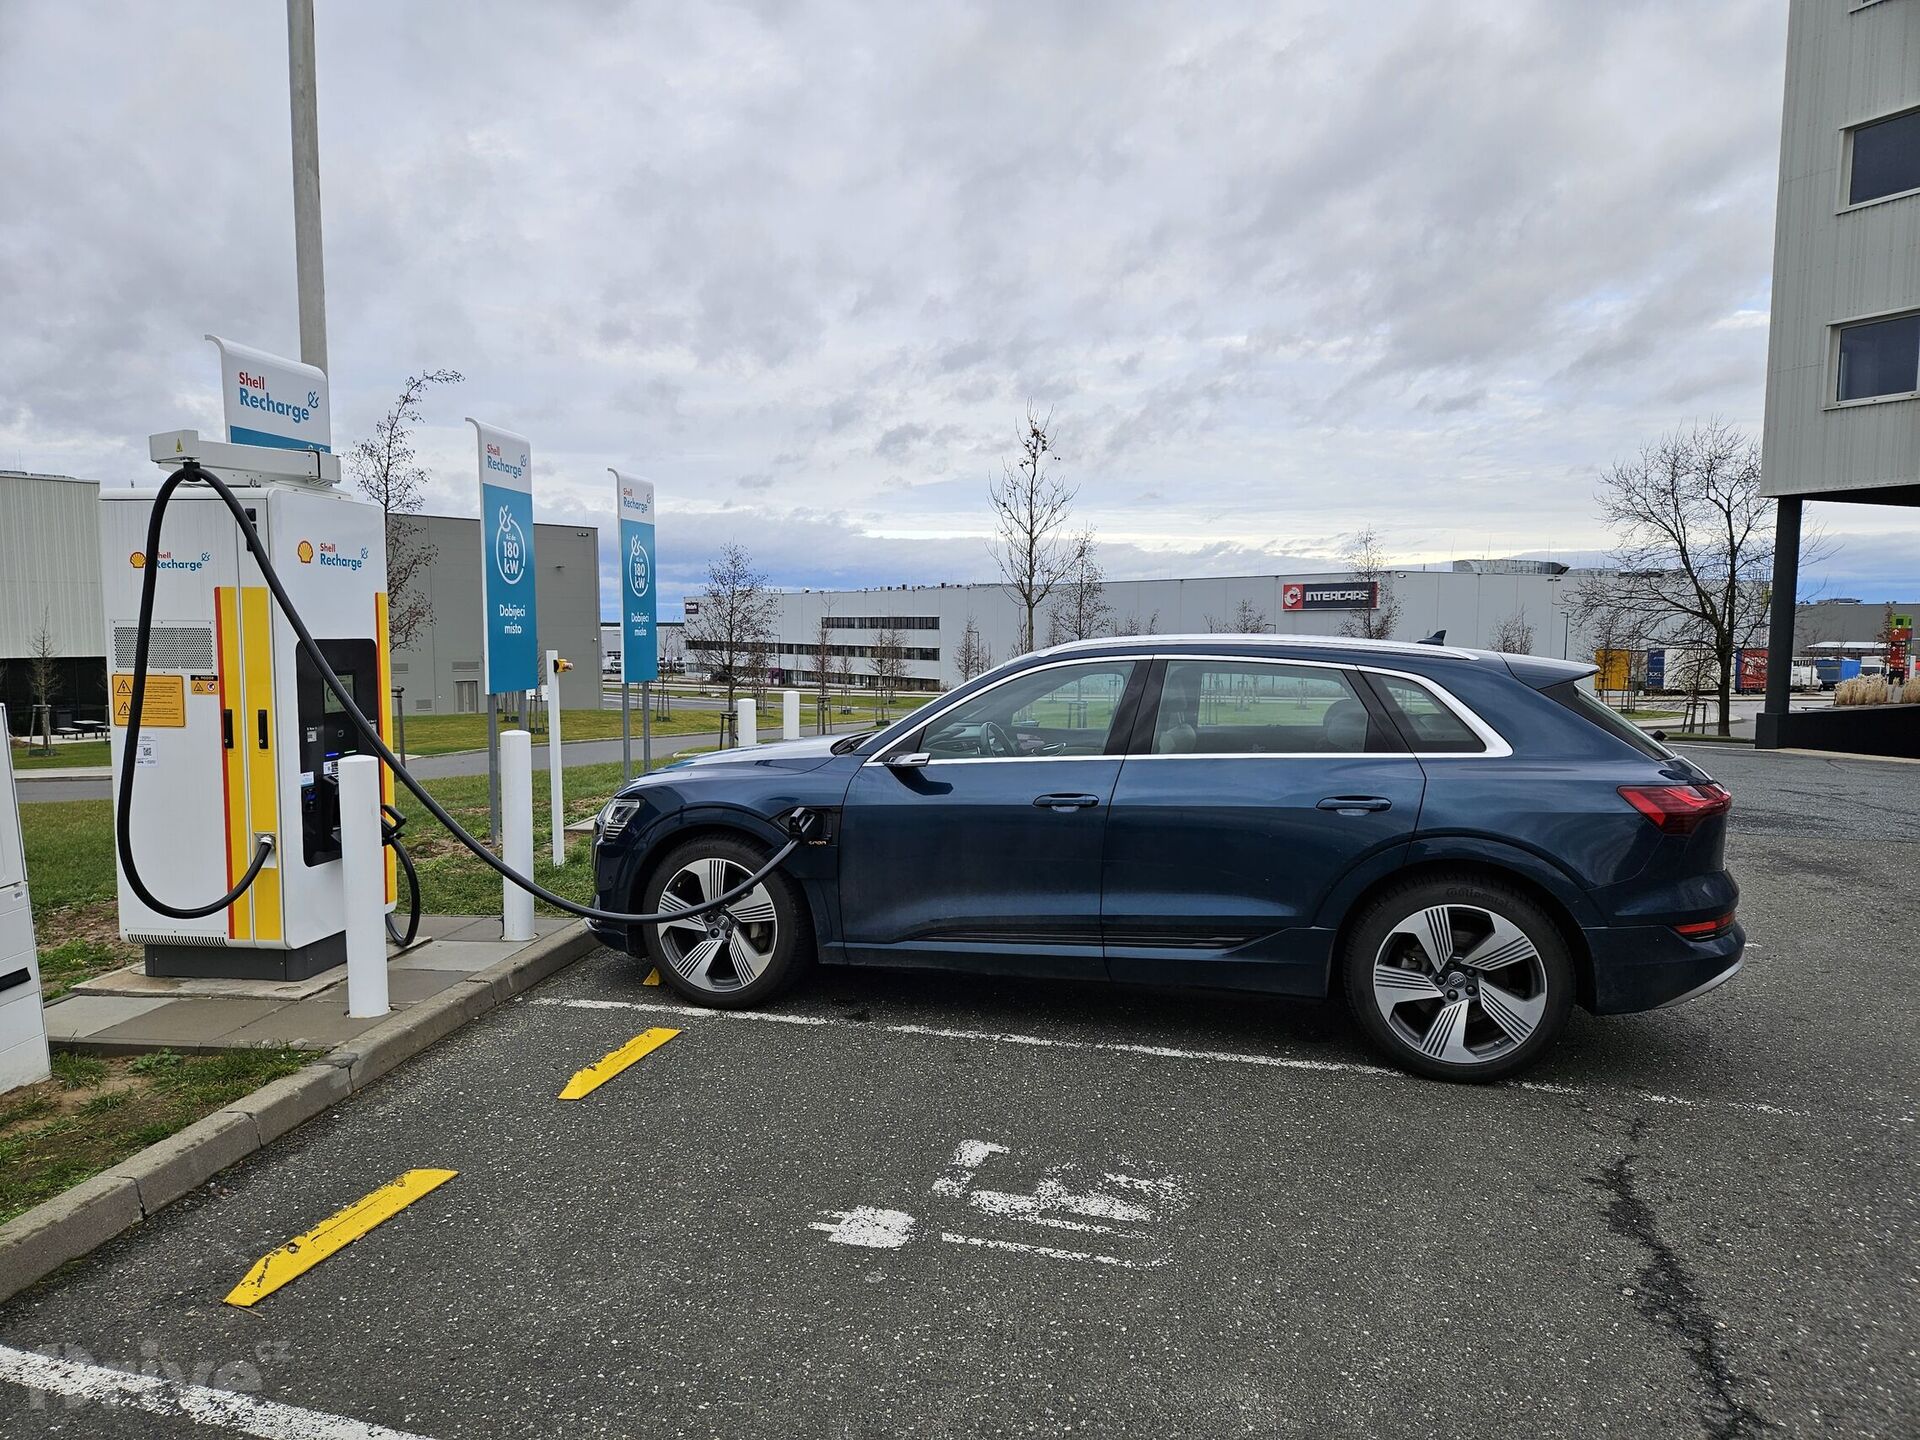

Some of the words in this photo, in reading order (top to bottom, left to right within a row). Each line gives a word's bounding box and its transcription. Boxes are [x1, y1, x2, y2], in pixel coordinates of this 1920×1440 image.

[239, 371, 265, 390] Shell
[239, 387, 310, 423] Recharge
[487, 443, 501, 456] Shell
[487, 454, 522, 479] Recharge
[623, 487, 632, 496] Shell
[623, 495, 648, 514] Recharge
[320, 542, 336, 553] Shell
[503, 541, 519, 559] 180
[320, 552, 362, 571] Recharge
[504, 557, 519, 575] kW
[634, 562, 646, 577] 180
[634, 576, 645, 589] kW
[504, 621, 522, 635] místo
